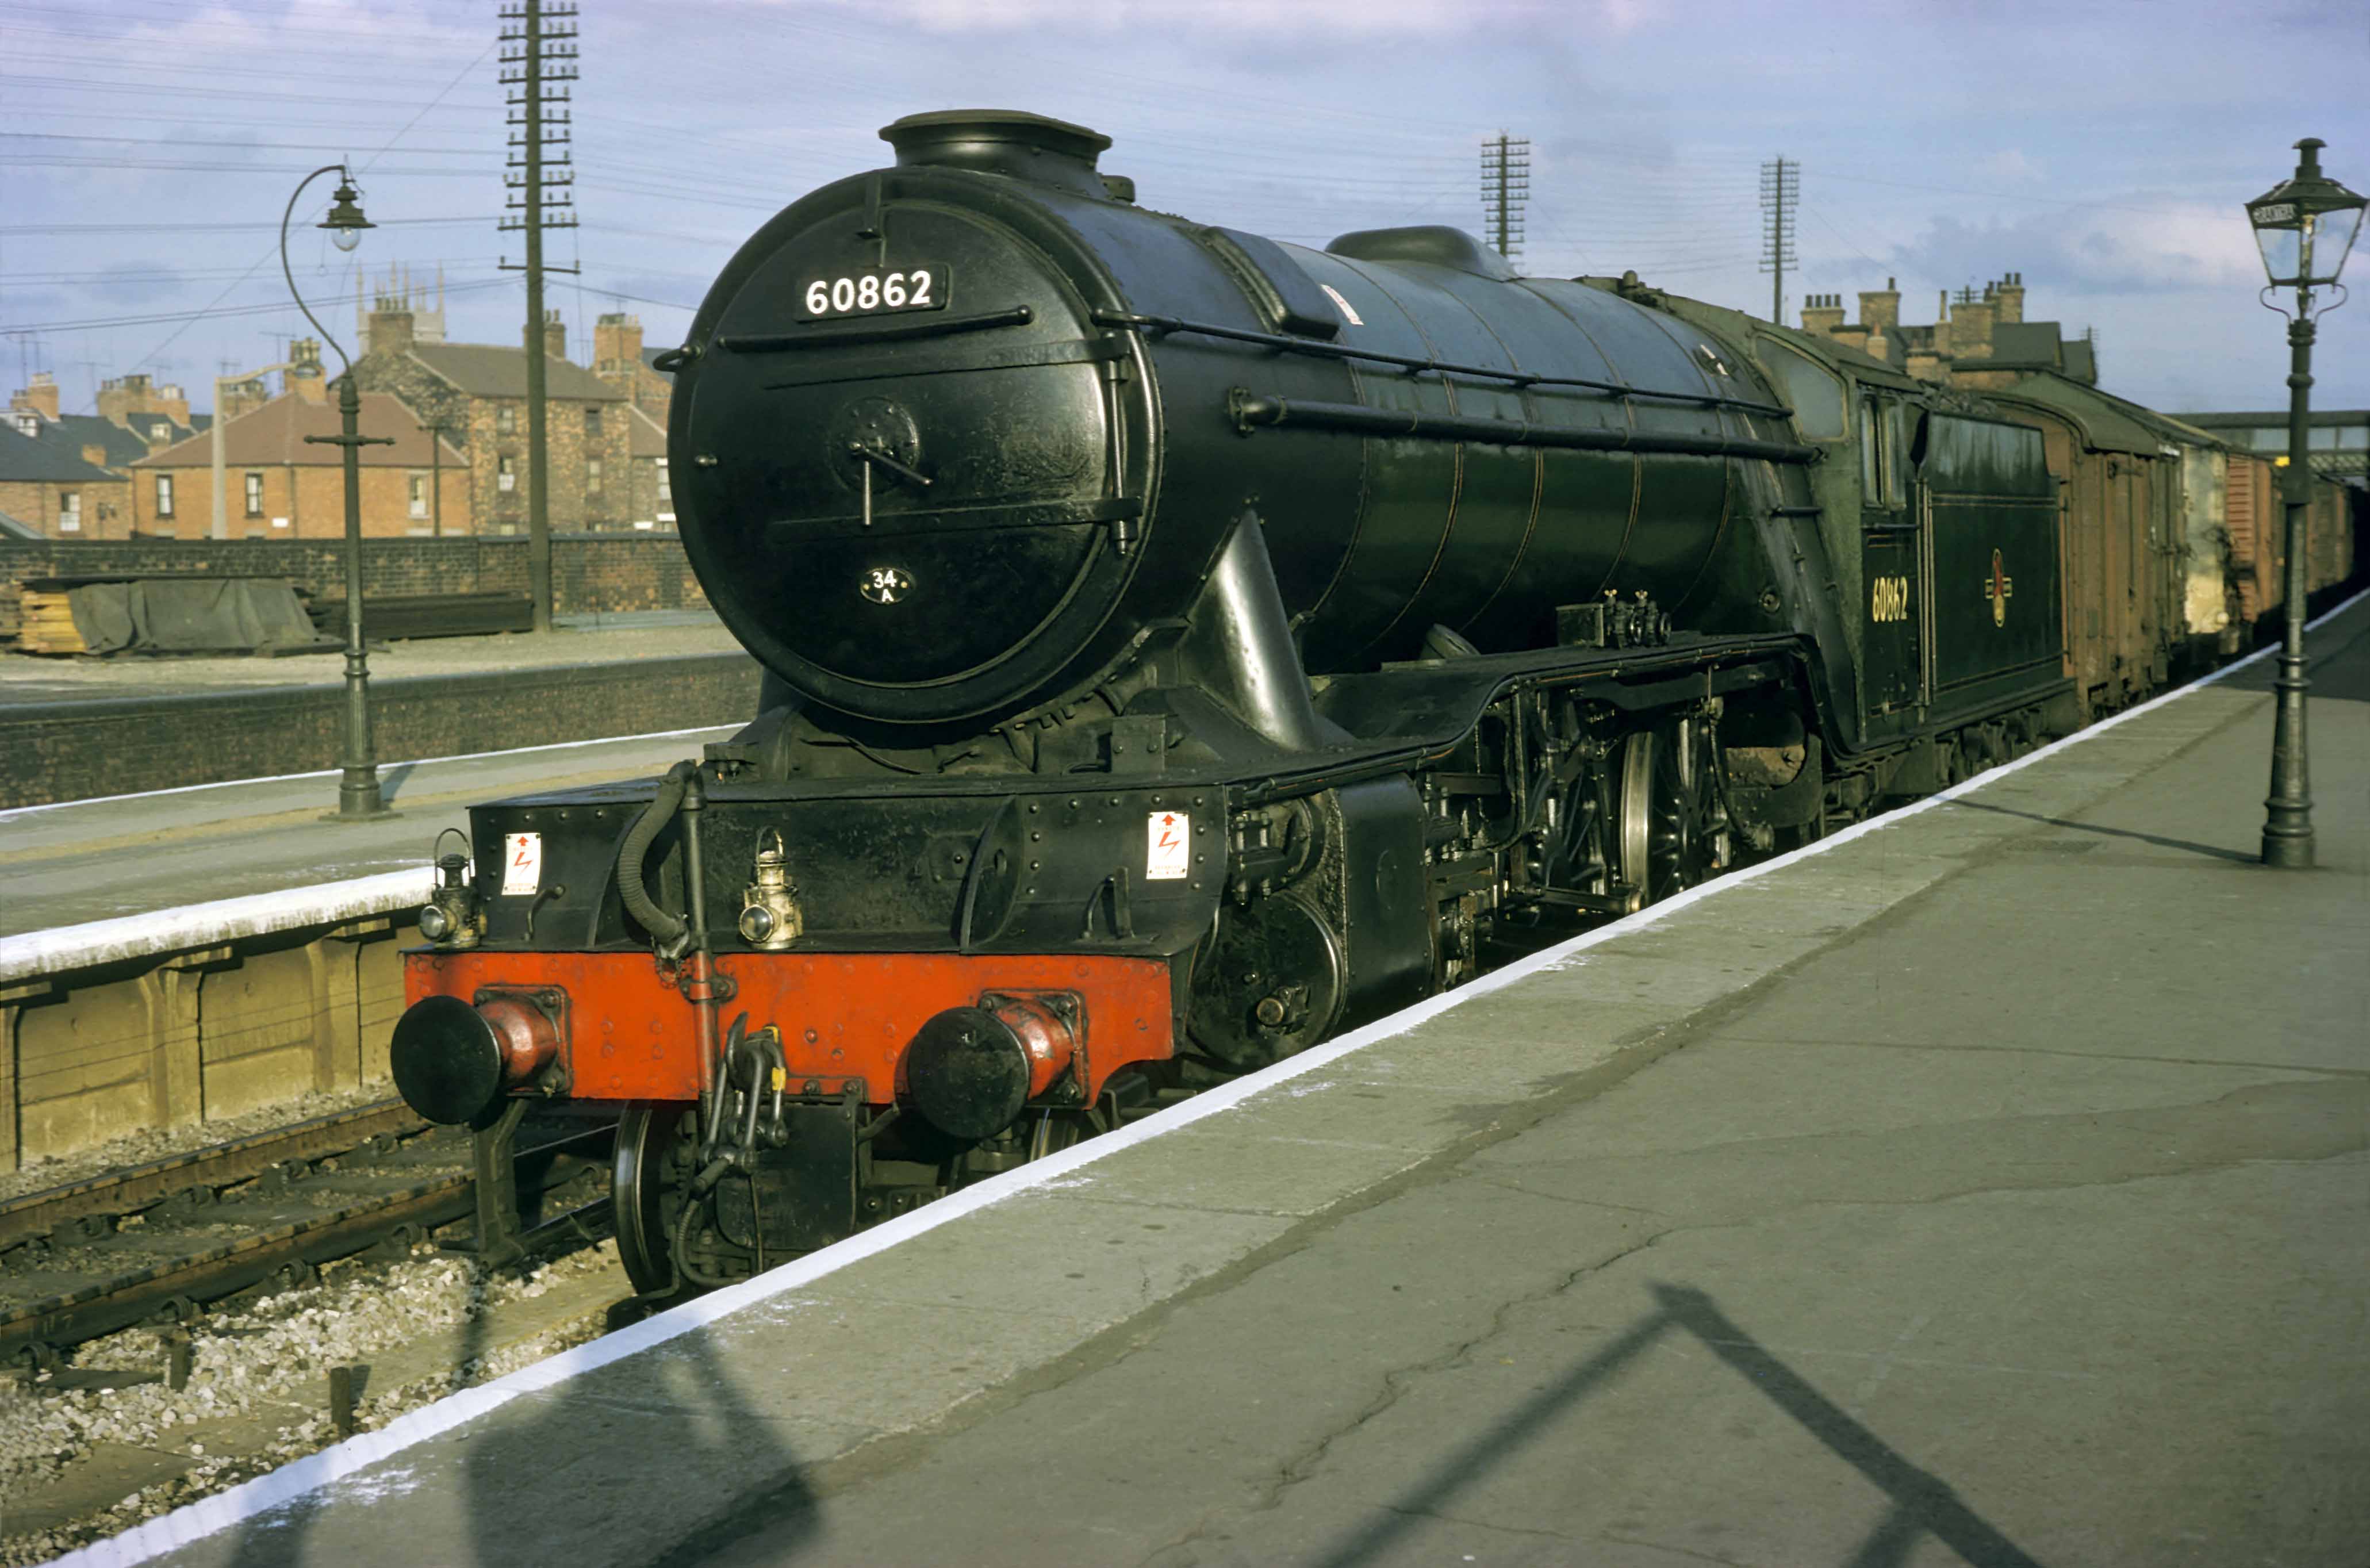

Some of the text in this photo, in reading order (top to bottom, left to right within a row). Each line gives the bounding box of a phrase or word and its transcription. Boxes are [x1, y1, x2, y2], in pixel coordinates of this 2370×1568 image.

[806, 270, 931, 315] 60862
[872, 570, 897, 588] 34
[881, 589, 894, 602] A
[1872, 576, 1908, 622] 60862
